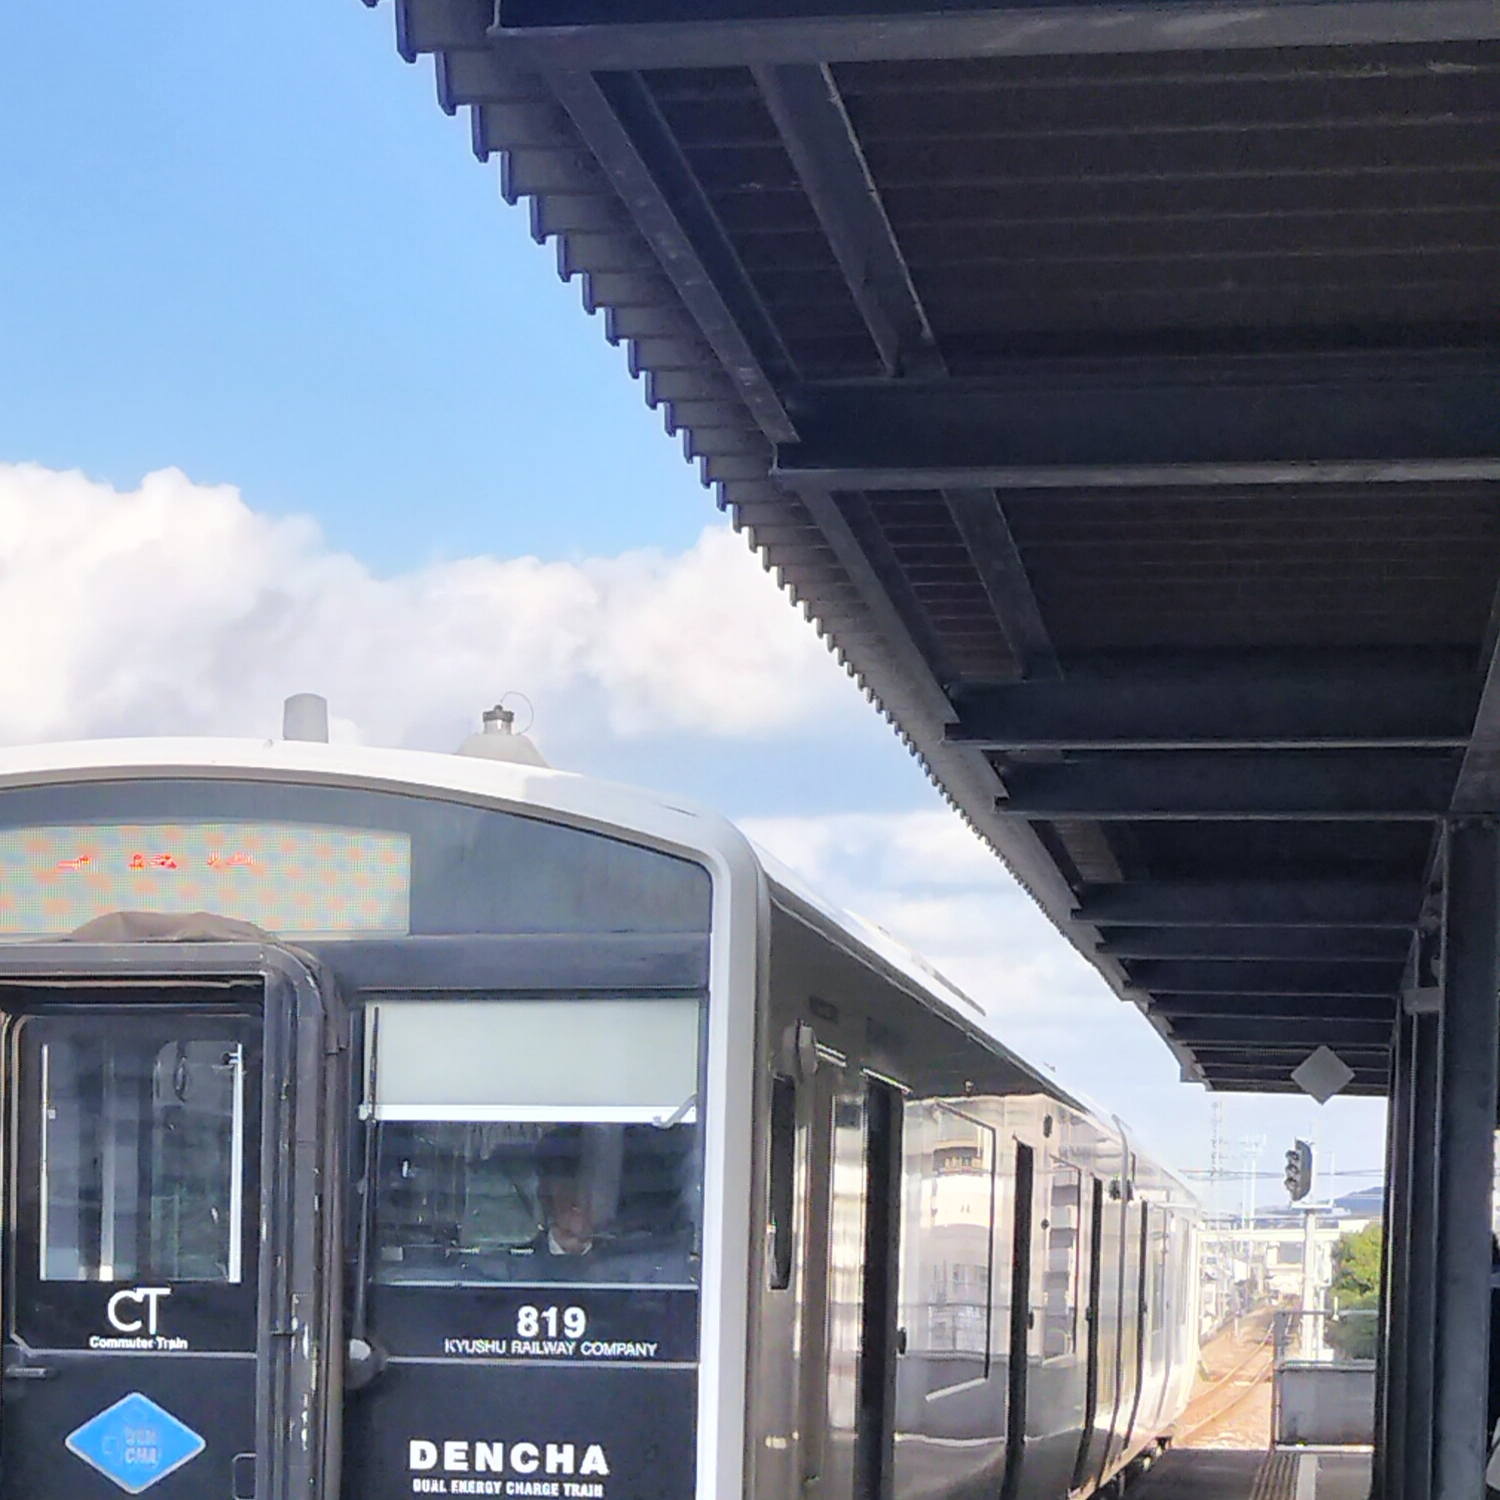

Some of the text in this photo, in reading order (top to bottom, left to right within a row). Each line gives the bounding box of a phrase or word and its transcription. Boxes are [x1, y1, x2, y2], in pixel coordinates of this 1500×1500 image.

[107, 1287, 171, 1335] CT
[517, 1305, 586, 1338] 819
[89, 1335, 188, 1349] Commuter Train
[444, 1338, 658, 1357] KYUSHU RAILWAY COMPANY
[409, 1440, 610, 1475] DENCHA
[413, 1478, 605, 1498] DUAL ENERGY CHARGE TRAIN
